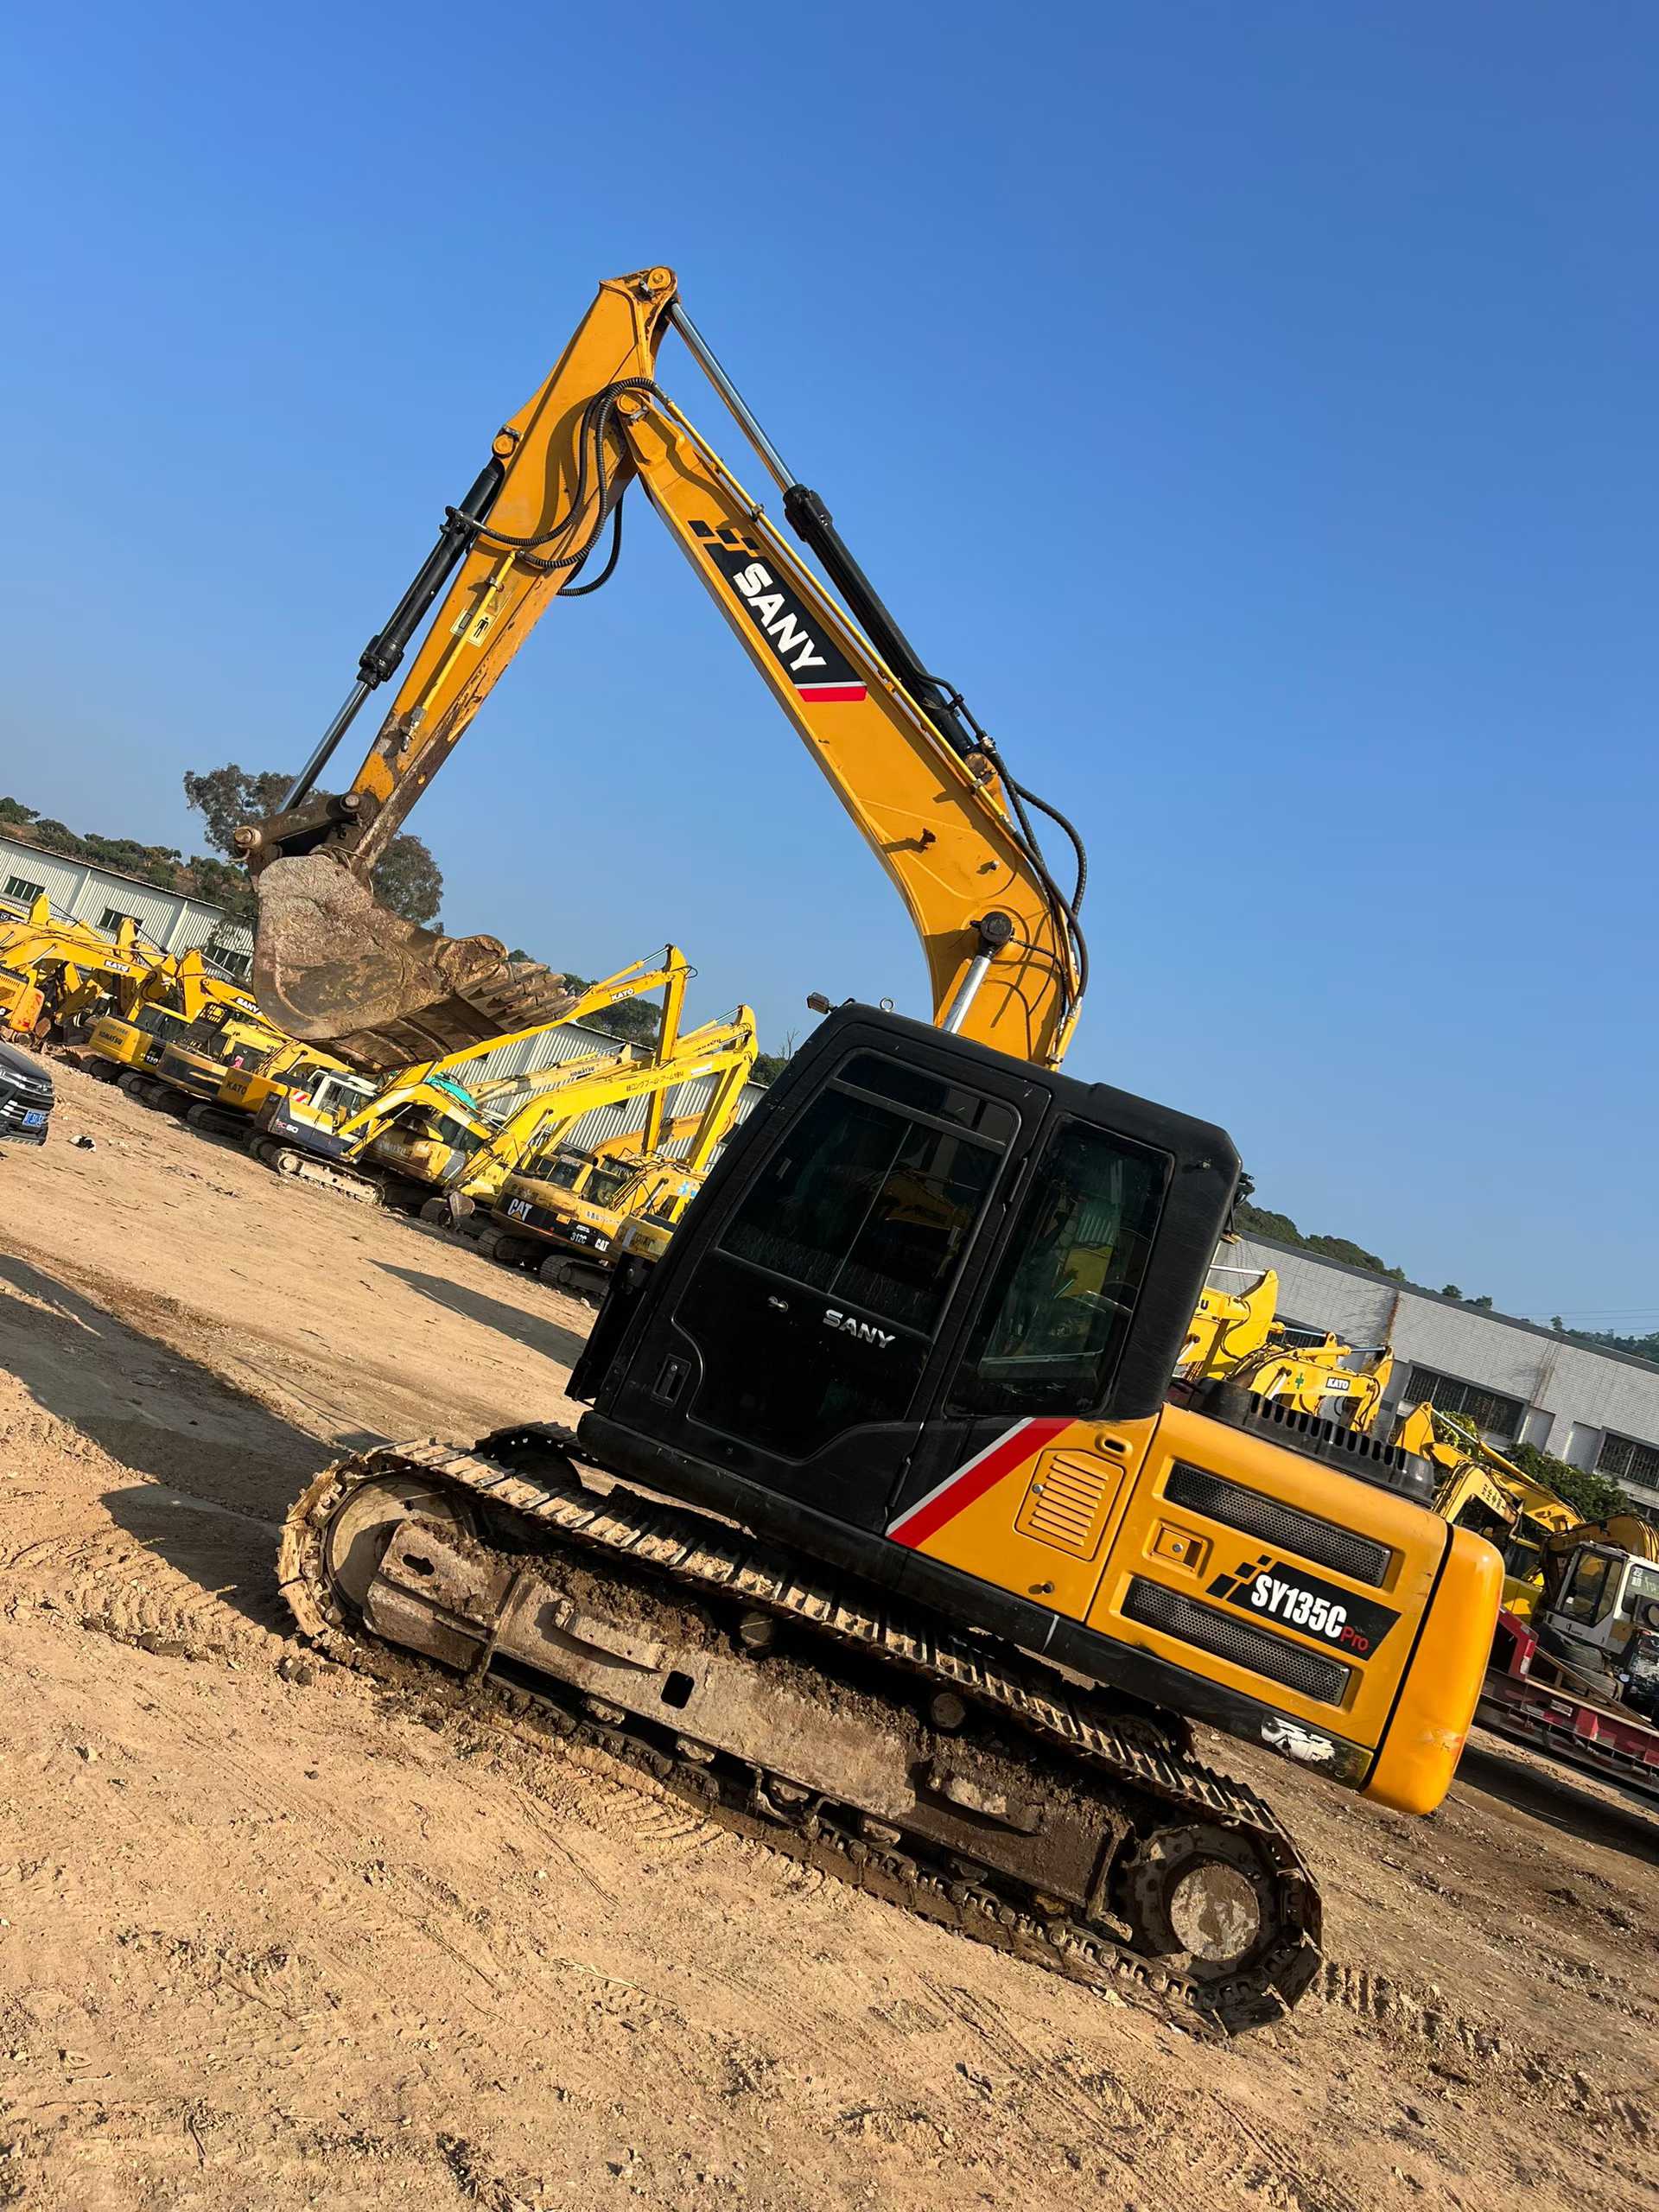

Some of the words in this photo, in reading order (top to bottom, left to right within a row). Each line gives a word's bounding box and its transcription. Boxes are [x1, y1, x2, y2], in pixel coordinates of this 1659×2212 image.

[733, 563, 827, 671] SANY
[105, 961, 129, 972] KATO
[611, 988, 634, 1001] KATO
[236, 997, 260, 1014] SANY
[226, 1082, 247, 1095] KATO
[507, 1198, 533, 1222] CAT
[570, 1231, 588, 1244] 312C
[594, 1237, 610, 1252] CAT
[823, 1309, 896, 1349] SANY
[1327, 1377, 1350, 1390] KATO
[1250, 1573, 1347, 1639] SY135C
[1340, 1625, 1370, 1652] Pro
